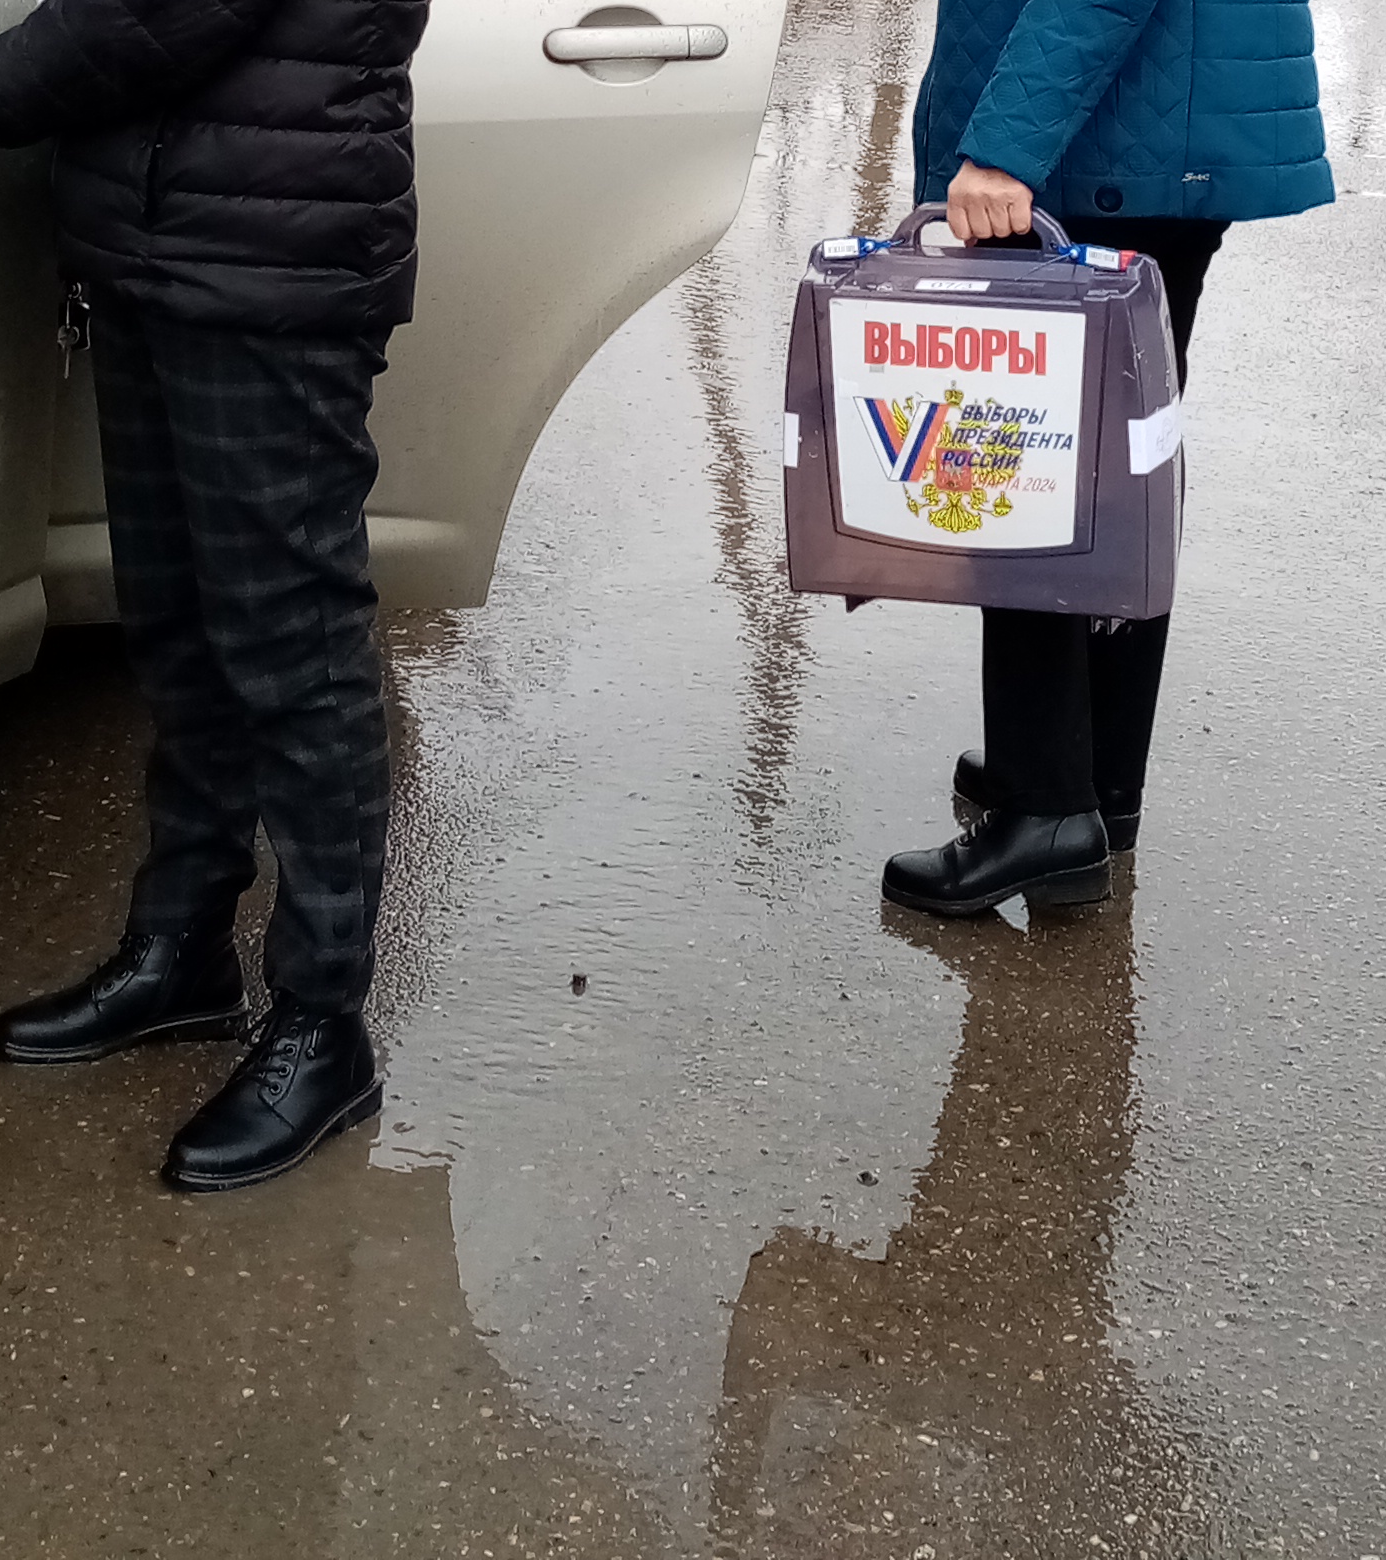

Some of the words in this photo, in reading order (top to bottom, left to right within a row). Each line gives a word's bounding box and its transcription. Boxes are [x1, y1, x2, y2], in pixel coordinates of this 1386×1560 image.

[864, 320, 1047, 376] ВЫБОРЫ
[960, 404, 1048, 425] ВЫБОРЫ
[951, 427, 1074, 450] ПРЕЗИДЕНТА
[941, 450, 1021, 471] РОССИИ
[1022, 477, 1057, 493] 2024
